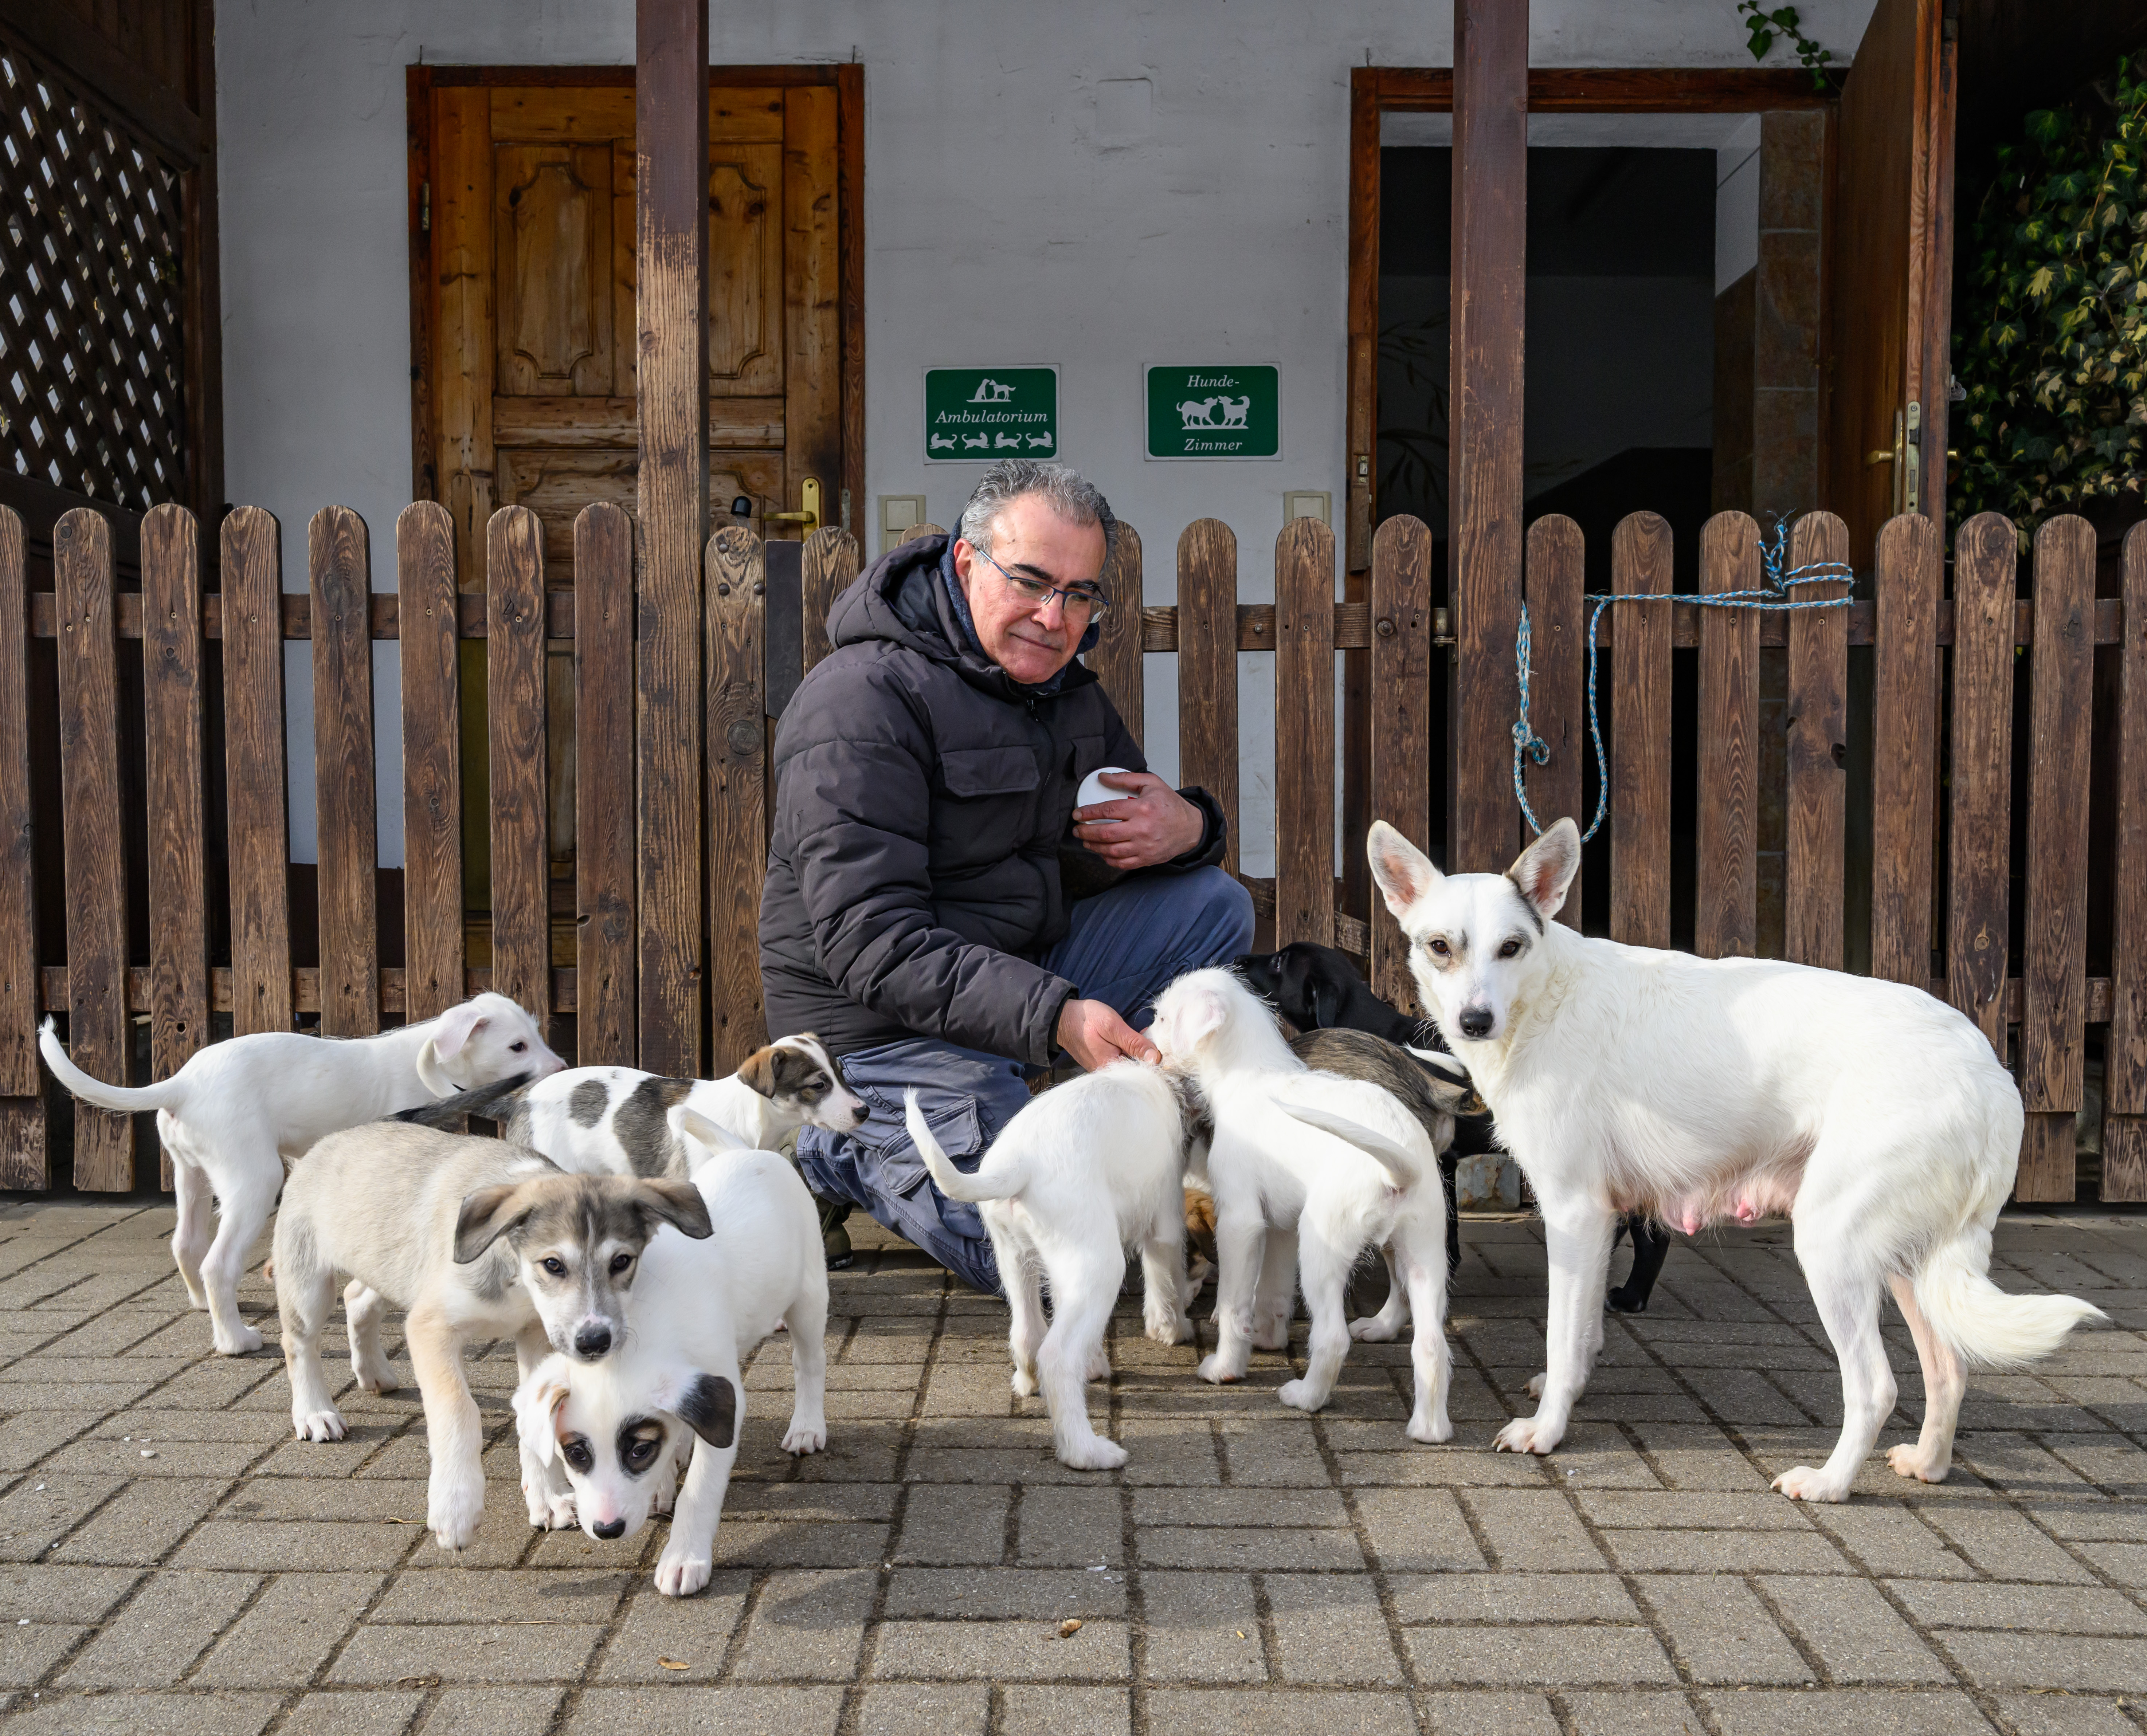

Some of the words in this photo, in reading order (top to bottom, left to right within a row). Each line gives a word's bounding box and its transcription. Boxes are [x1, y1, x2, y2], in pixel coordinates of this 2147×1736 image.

[1187, 375, 1239, 387] Hunde-
[935, 410, 1048, 423] Ambulatorium
[1184, 438, 1242, 451] Zimmer
